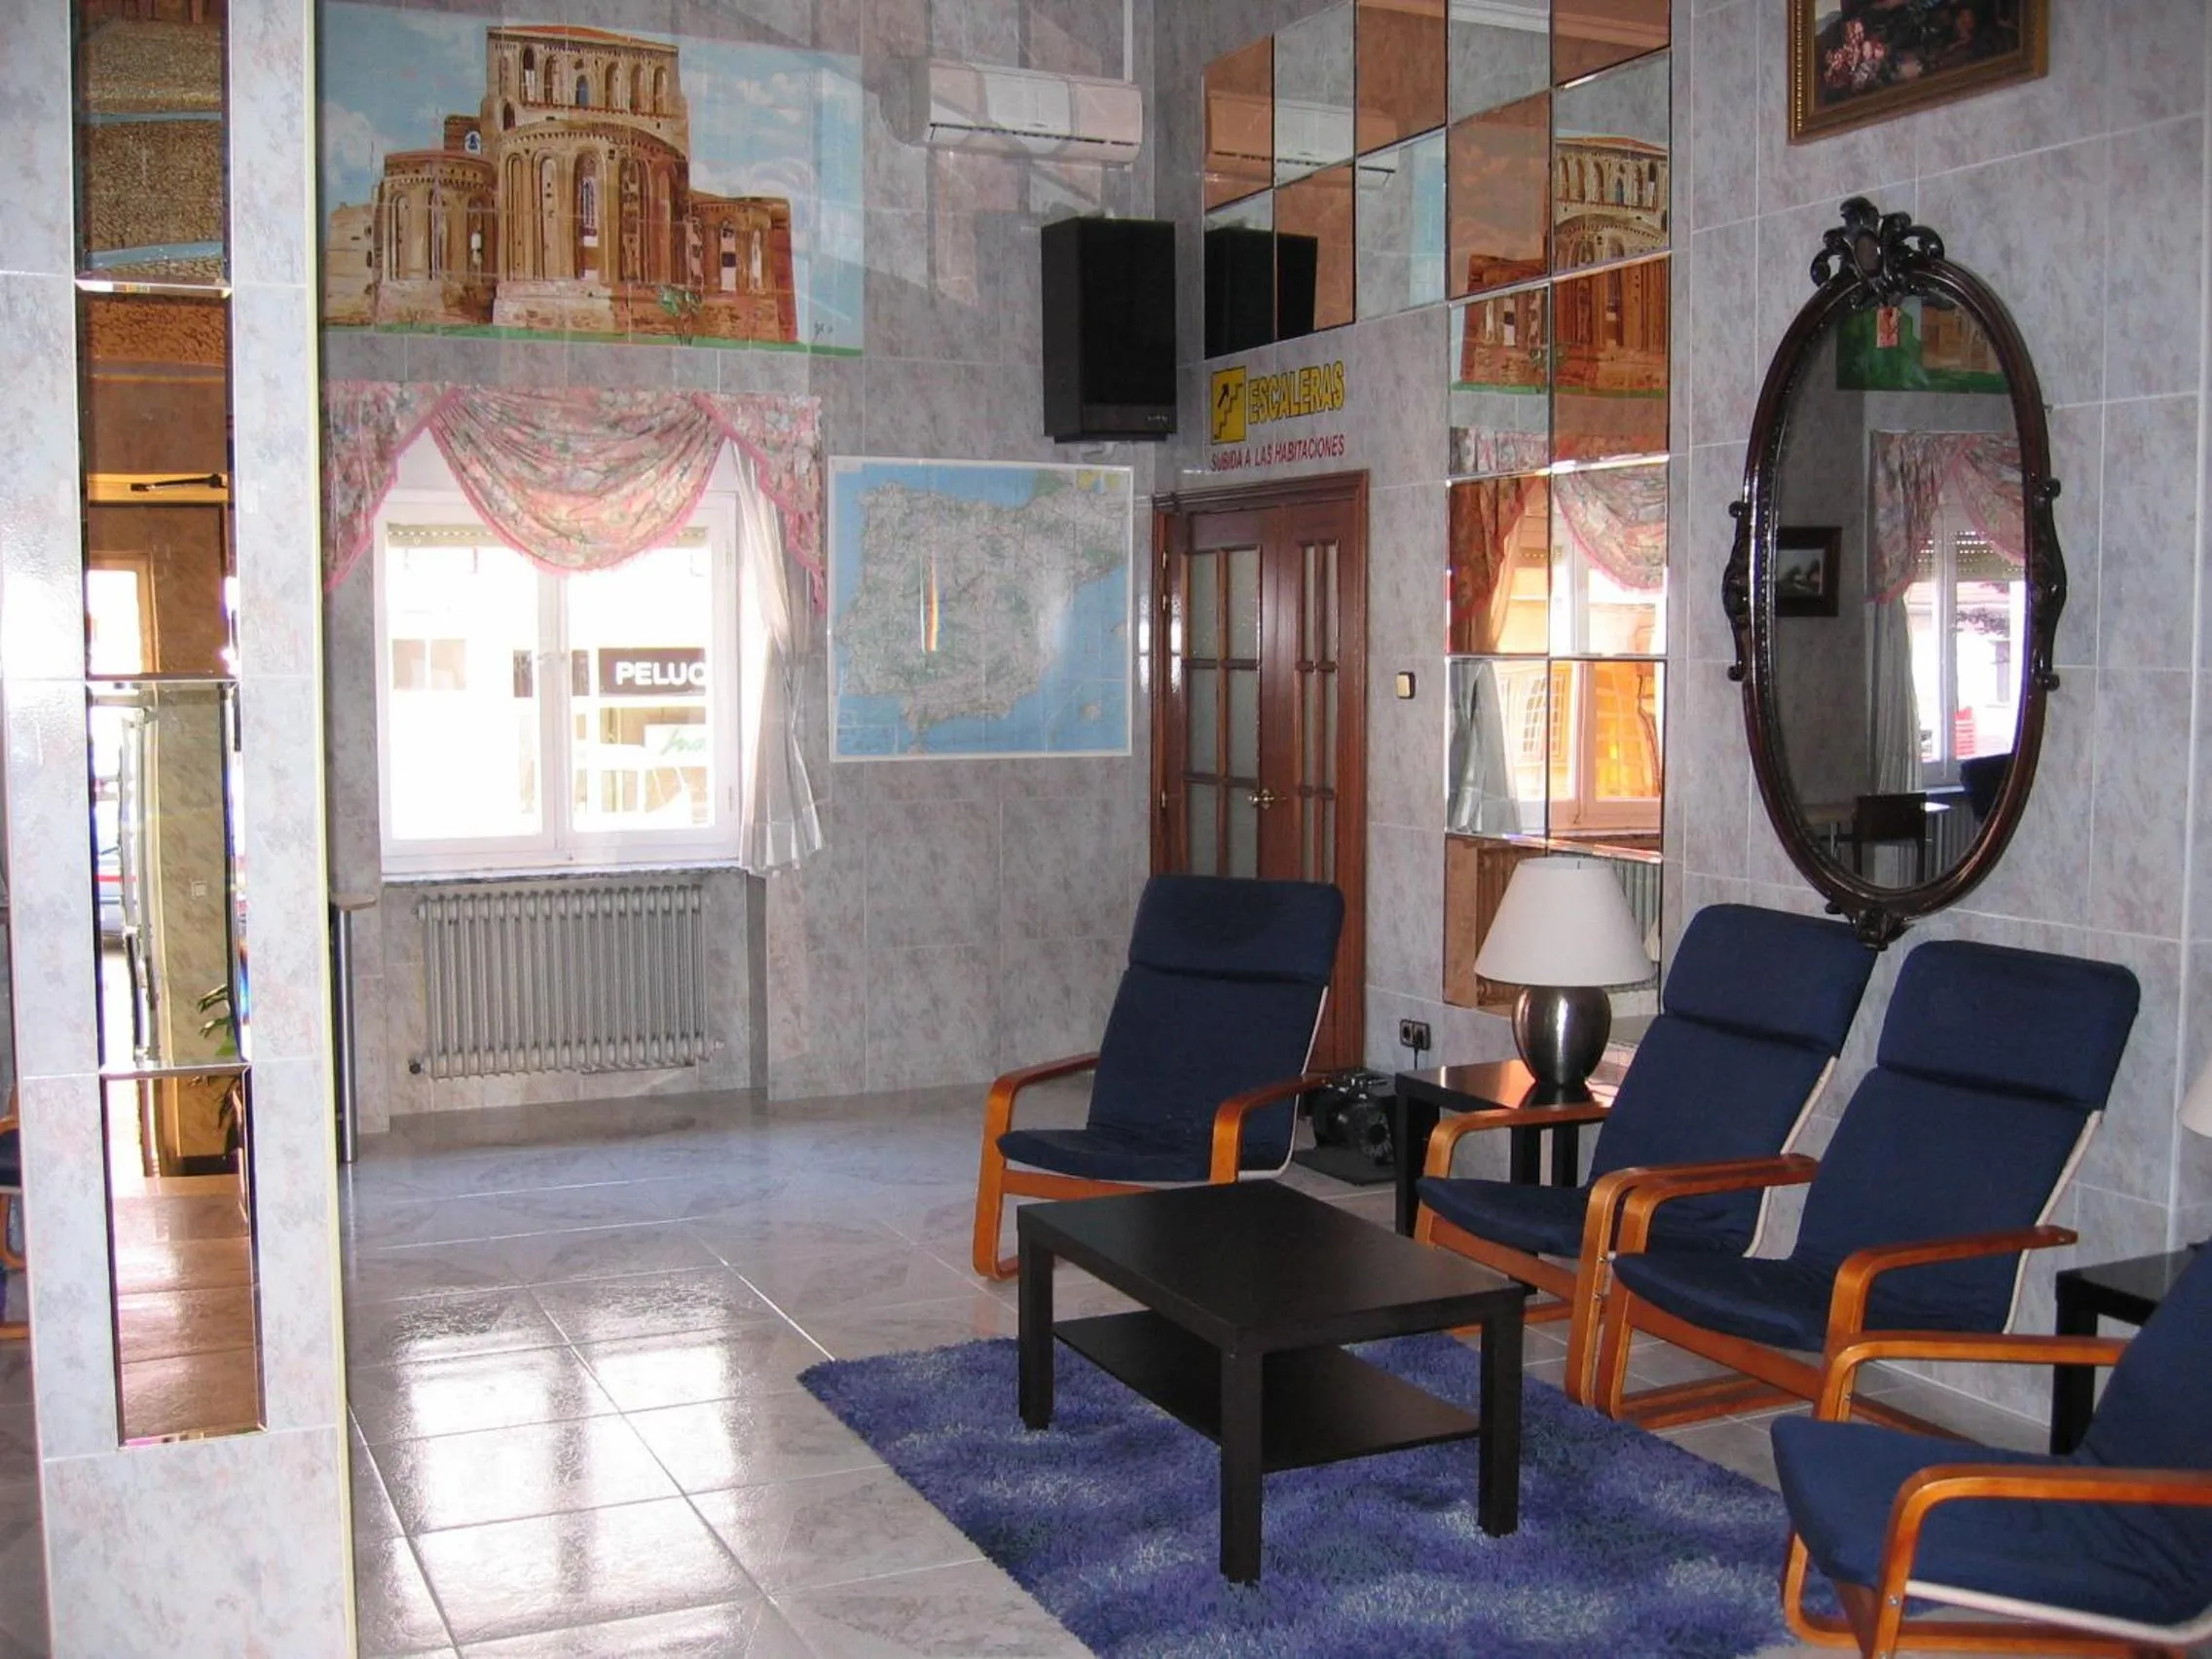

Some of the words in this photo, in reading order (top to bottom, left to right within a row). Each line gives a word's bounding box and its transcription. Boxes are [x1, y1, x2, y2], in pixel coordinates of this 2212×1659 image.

[1247, 360, 1346, 425] ESCALERAS
[1211, 449, 1242, 472] SUBIDA
[1245, 448, 1251, 469] A
[1254, 443, 1272, 467] LAS
[1274, 434, 1345, 464] HABITACIONES
